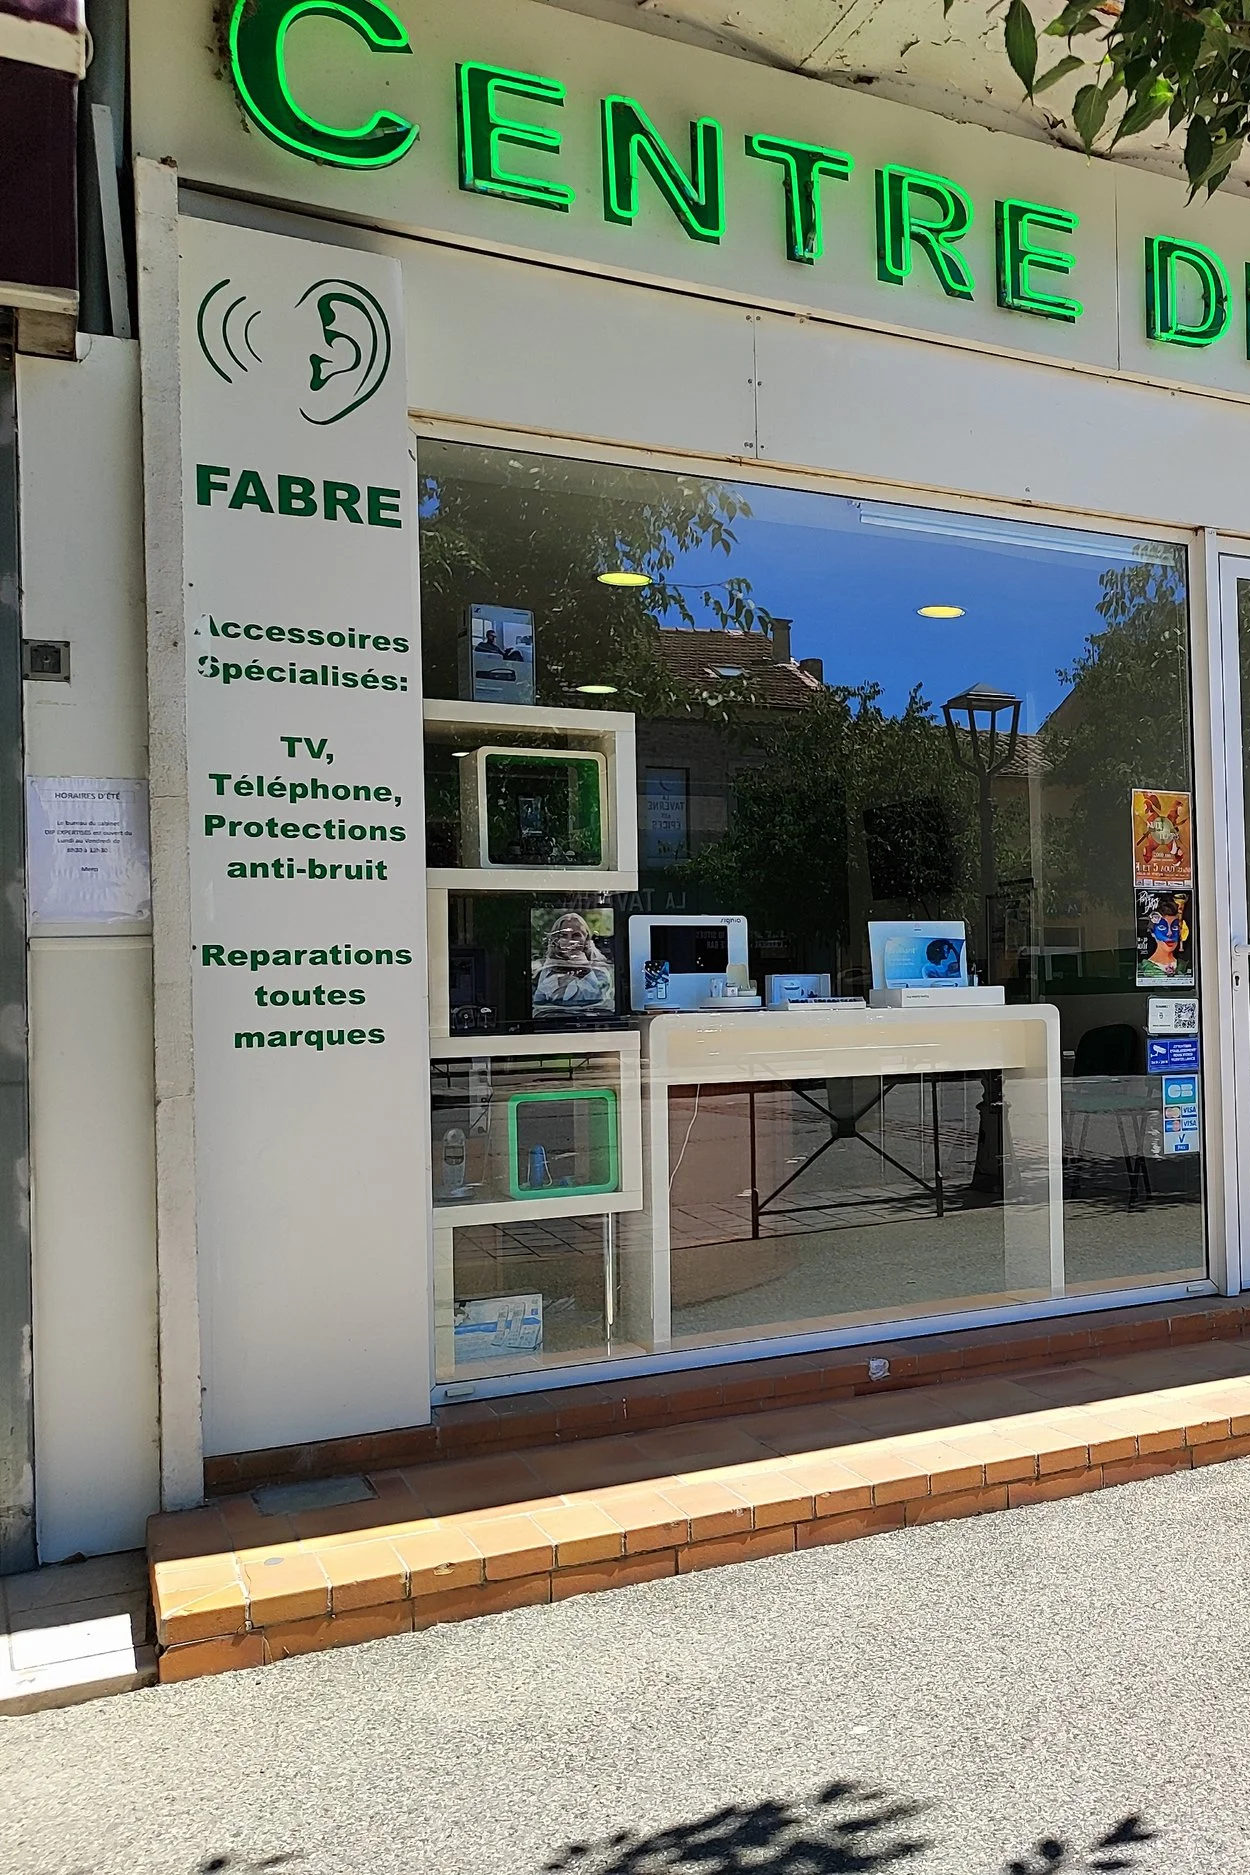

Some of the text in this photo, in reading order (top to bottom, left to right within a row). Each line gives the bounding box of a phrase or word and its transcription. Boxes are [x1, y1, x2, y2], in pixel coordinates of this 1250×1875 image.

[228, 0, 1084, 322] CENTRE
[196, 464, 402, 529] FABRE
[197, 655, 408, 692] Spécialisés:
[280, 736, 334, 765] TV,
[55, 792, 96, 800] HORAIRES
[208, 773, 402, 808] Téléphone,
[204, 814, 407, 842] Protections
[227, 858, 388, 881] anti-bruit
[202, 944, 413, 971] Reparations
[255, 985, 366, 1007] toutes
[234, 1028, 386, 1051] marques
[1168, 1084, 1193, 1098] CB
[1184, 1119, 1197, 1127] VISA
